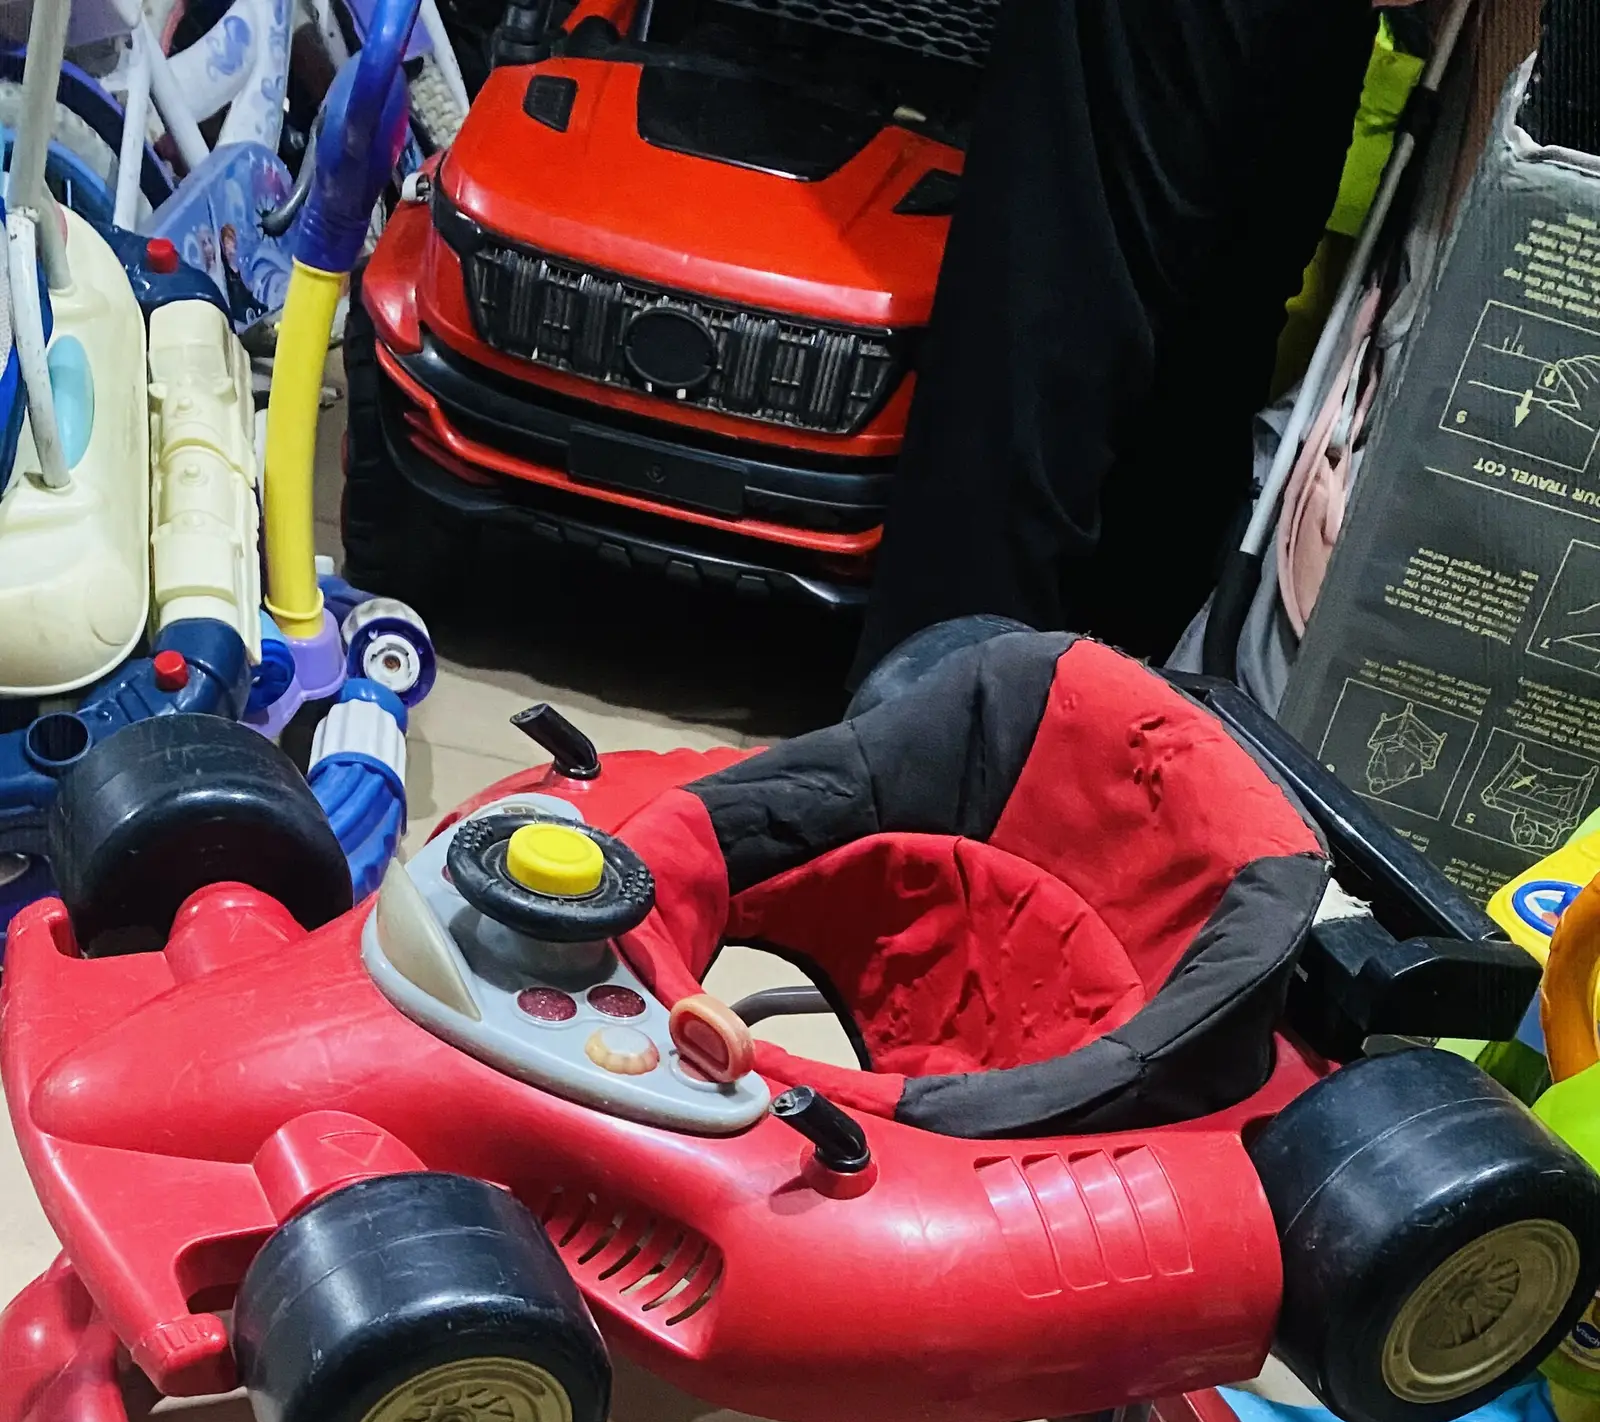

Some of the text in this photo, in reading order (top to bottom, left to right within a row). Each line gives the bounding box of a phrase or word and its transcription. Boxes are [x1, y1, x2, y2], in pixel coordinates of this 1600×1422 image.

[1472, 457, 1506, 477] COT
[1510, 467, 1567, 497] TRAVEL
[1403, 578, 1419, 589] the
[1451, 582, 1466, 592] the
[1467, 588, 1479, 596] of
[1421, 596, 1437, 607] the
[1462, 598, 1481, 608] and
[1413, 605, 1434, 617] tabs
[1438, 601, 1475, 619] through
[1434, 612, 1462, 626] velcro
[1463, 622, 1480, 632] the
[1531, 702, 1543, 713] by
[1521, 712, 1533, 720] of
[1465, 812, 1476, 824] 5
